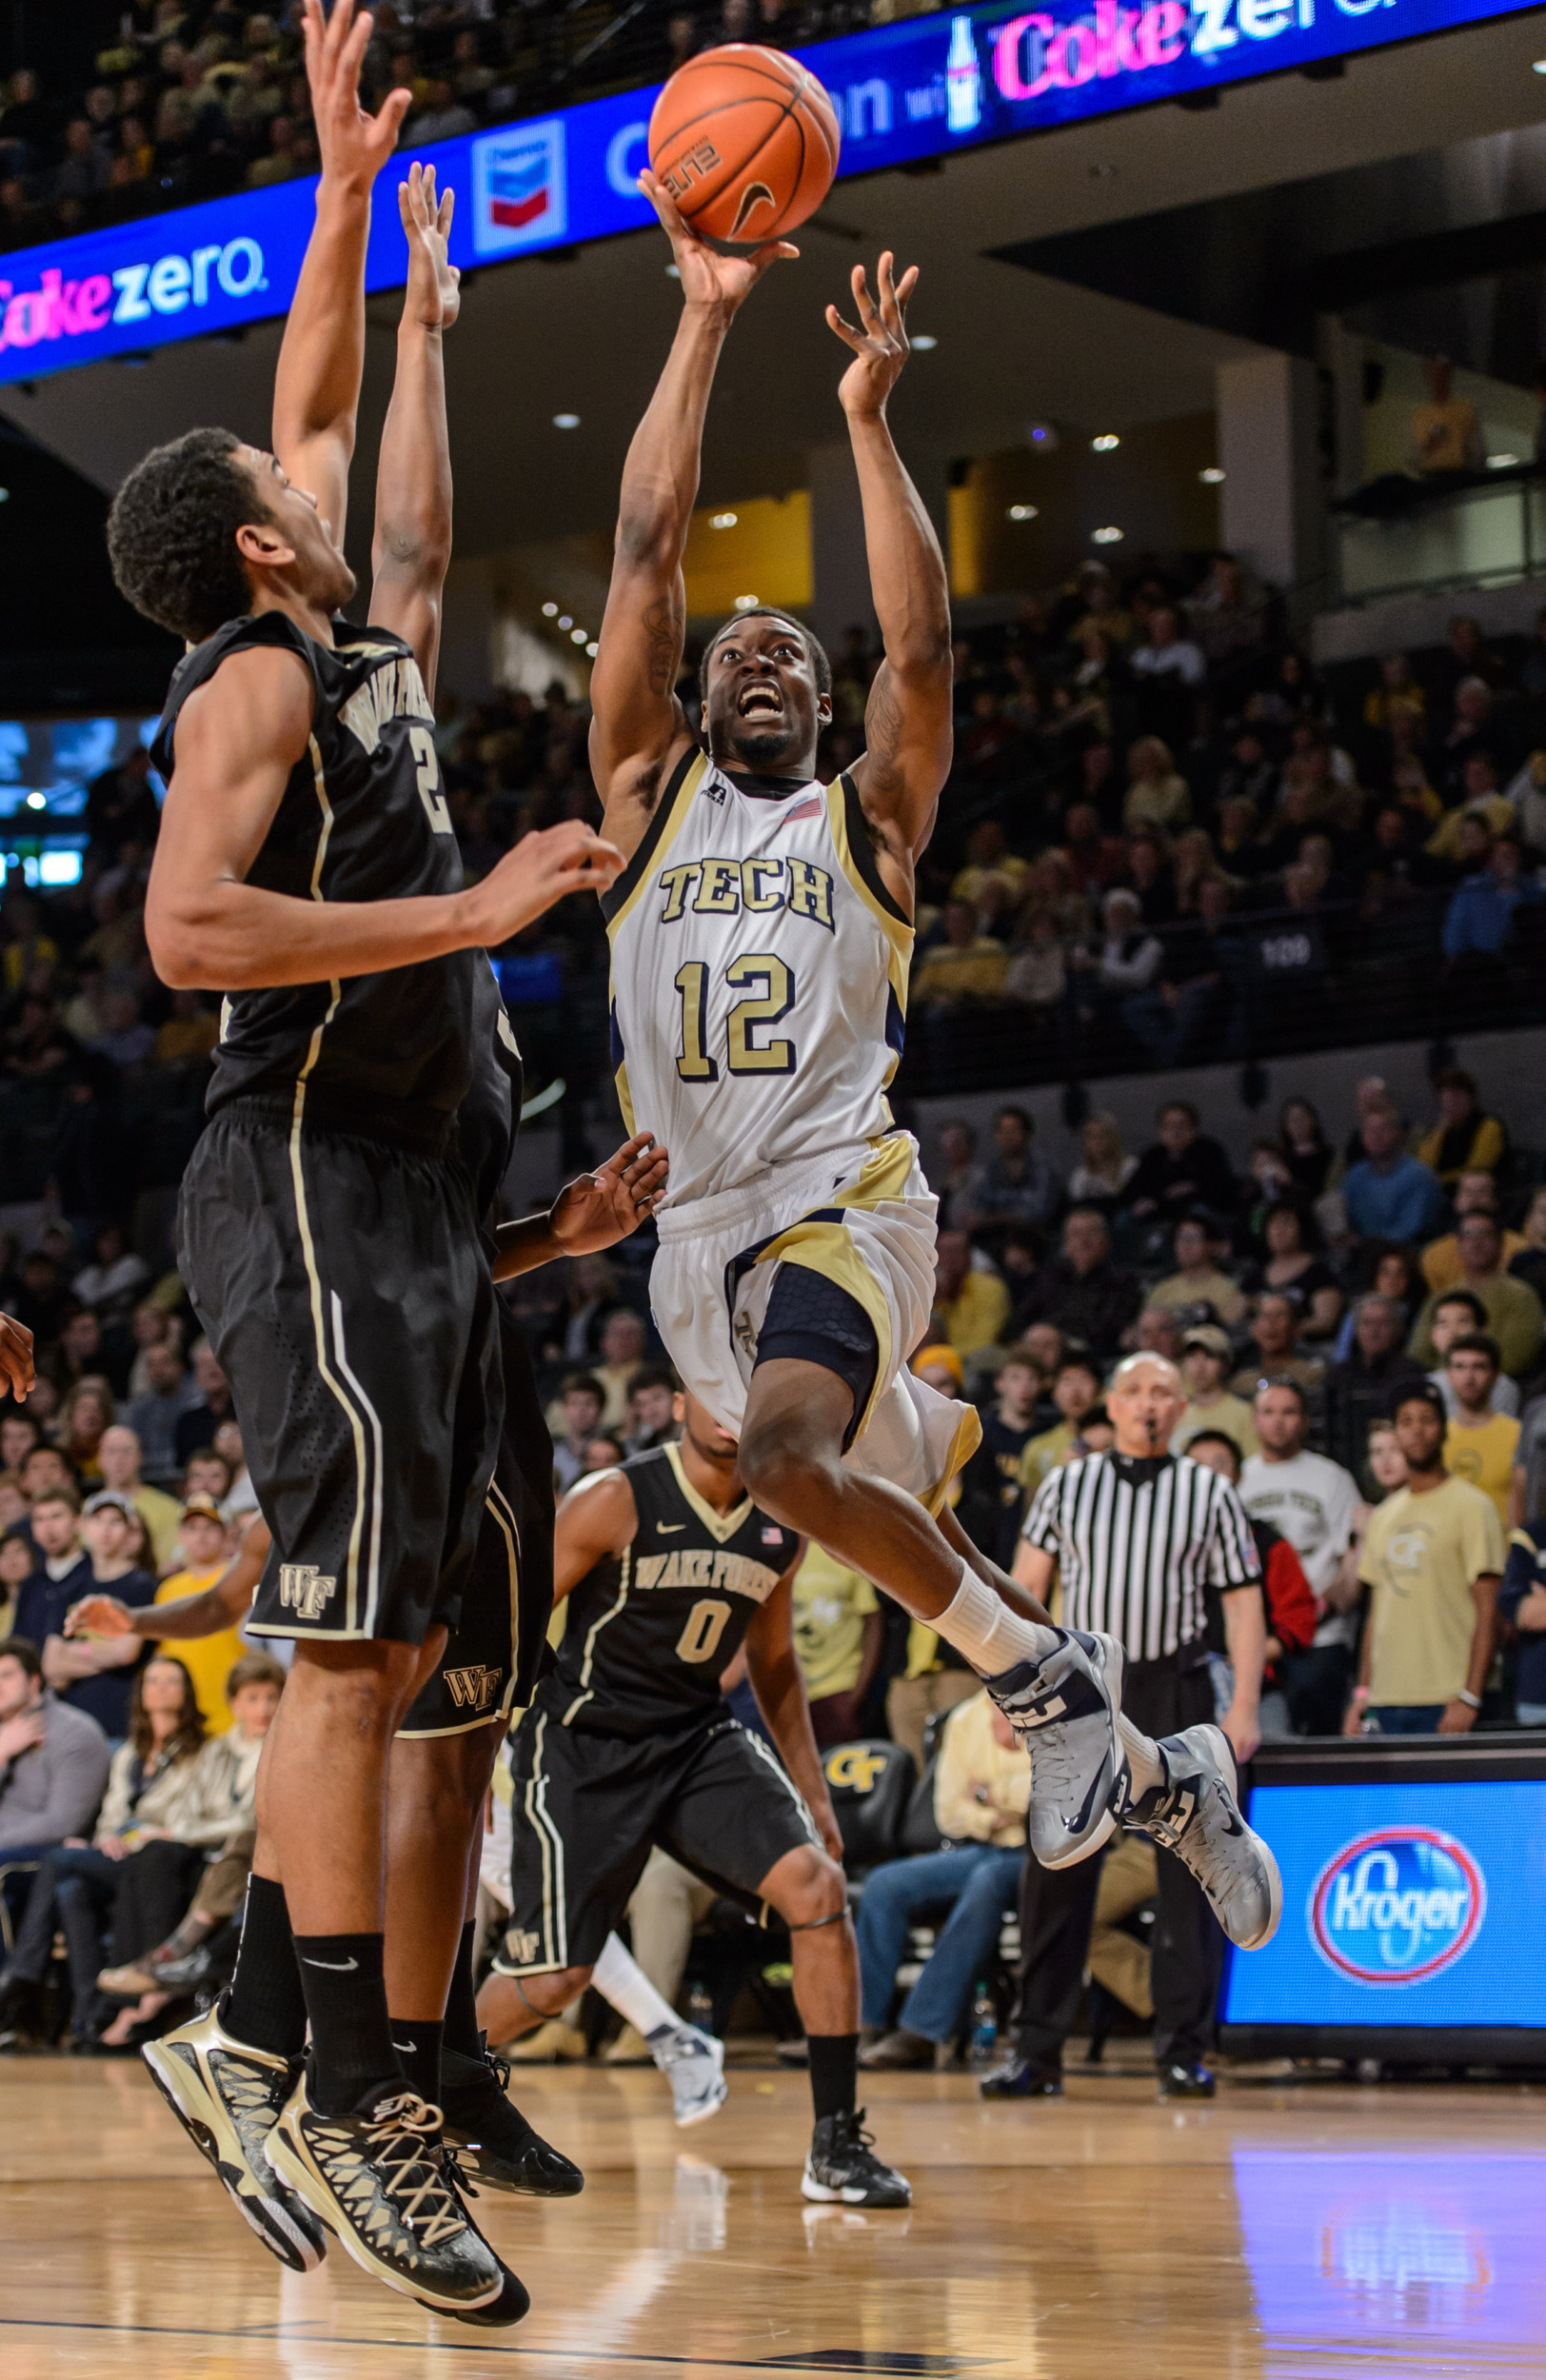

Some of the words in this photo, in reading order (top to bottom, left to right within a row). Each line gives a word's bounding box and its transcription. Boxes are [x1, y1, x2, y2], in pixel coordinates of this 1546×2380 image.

[993, 0, 1187, 101] Coke
[664, 142, 722, 200] ELITE
[659, 856, 835, 935] TECH
[674, 953, 797, 1083] 12
[279, 1563, 337, 1619] WF
[635, 1549, 714, 1590] WAKE
[709, 1549, 782, 1607] FORES
[675, 1598, 732, 1663] 0
[443, 1664, 503, 1712] WF
[826, 1746, 887, 1794] GT
[1332, 1851, 1469, 1966] Kroger
